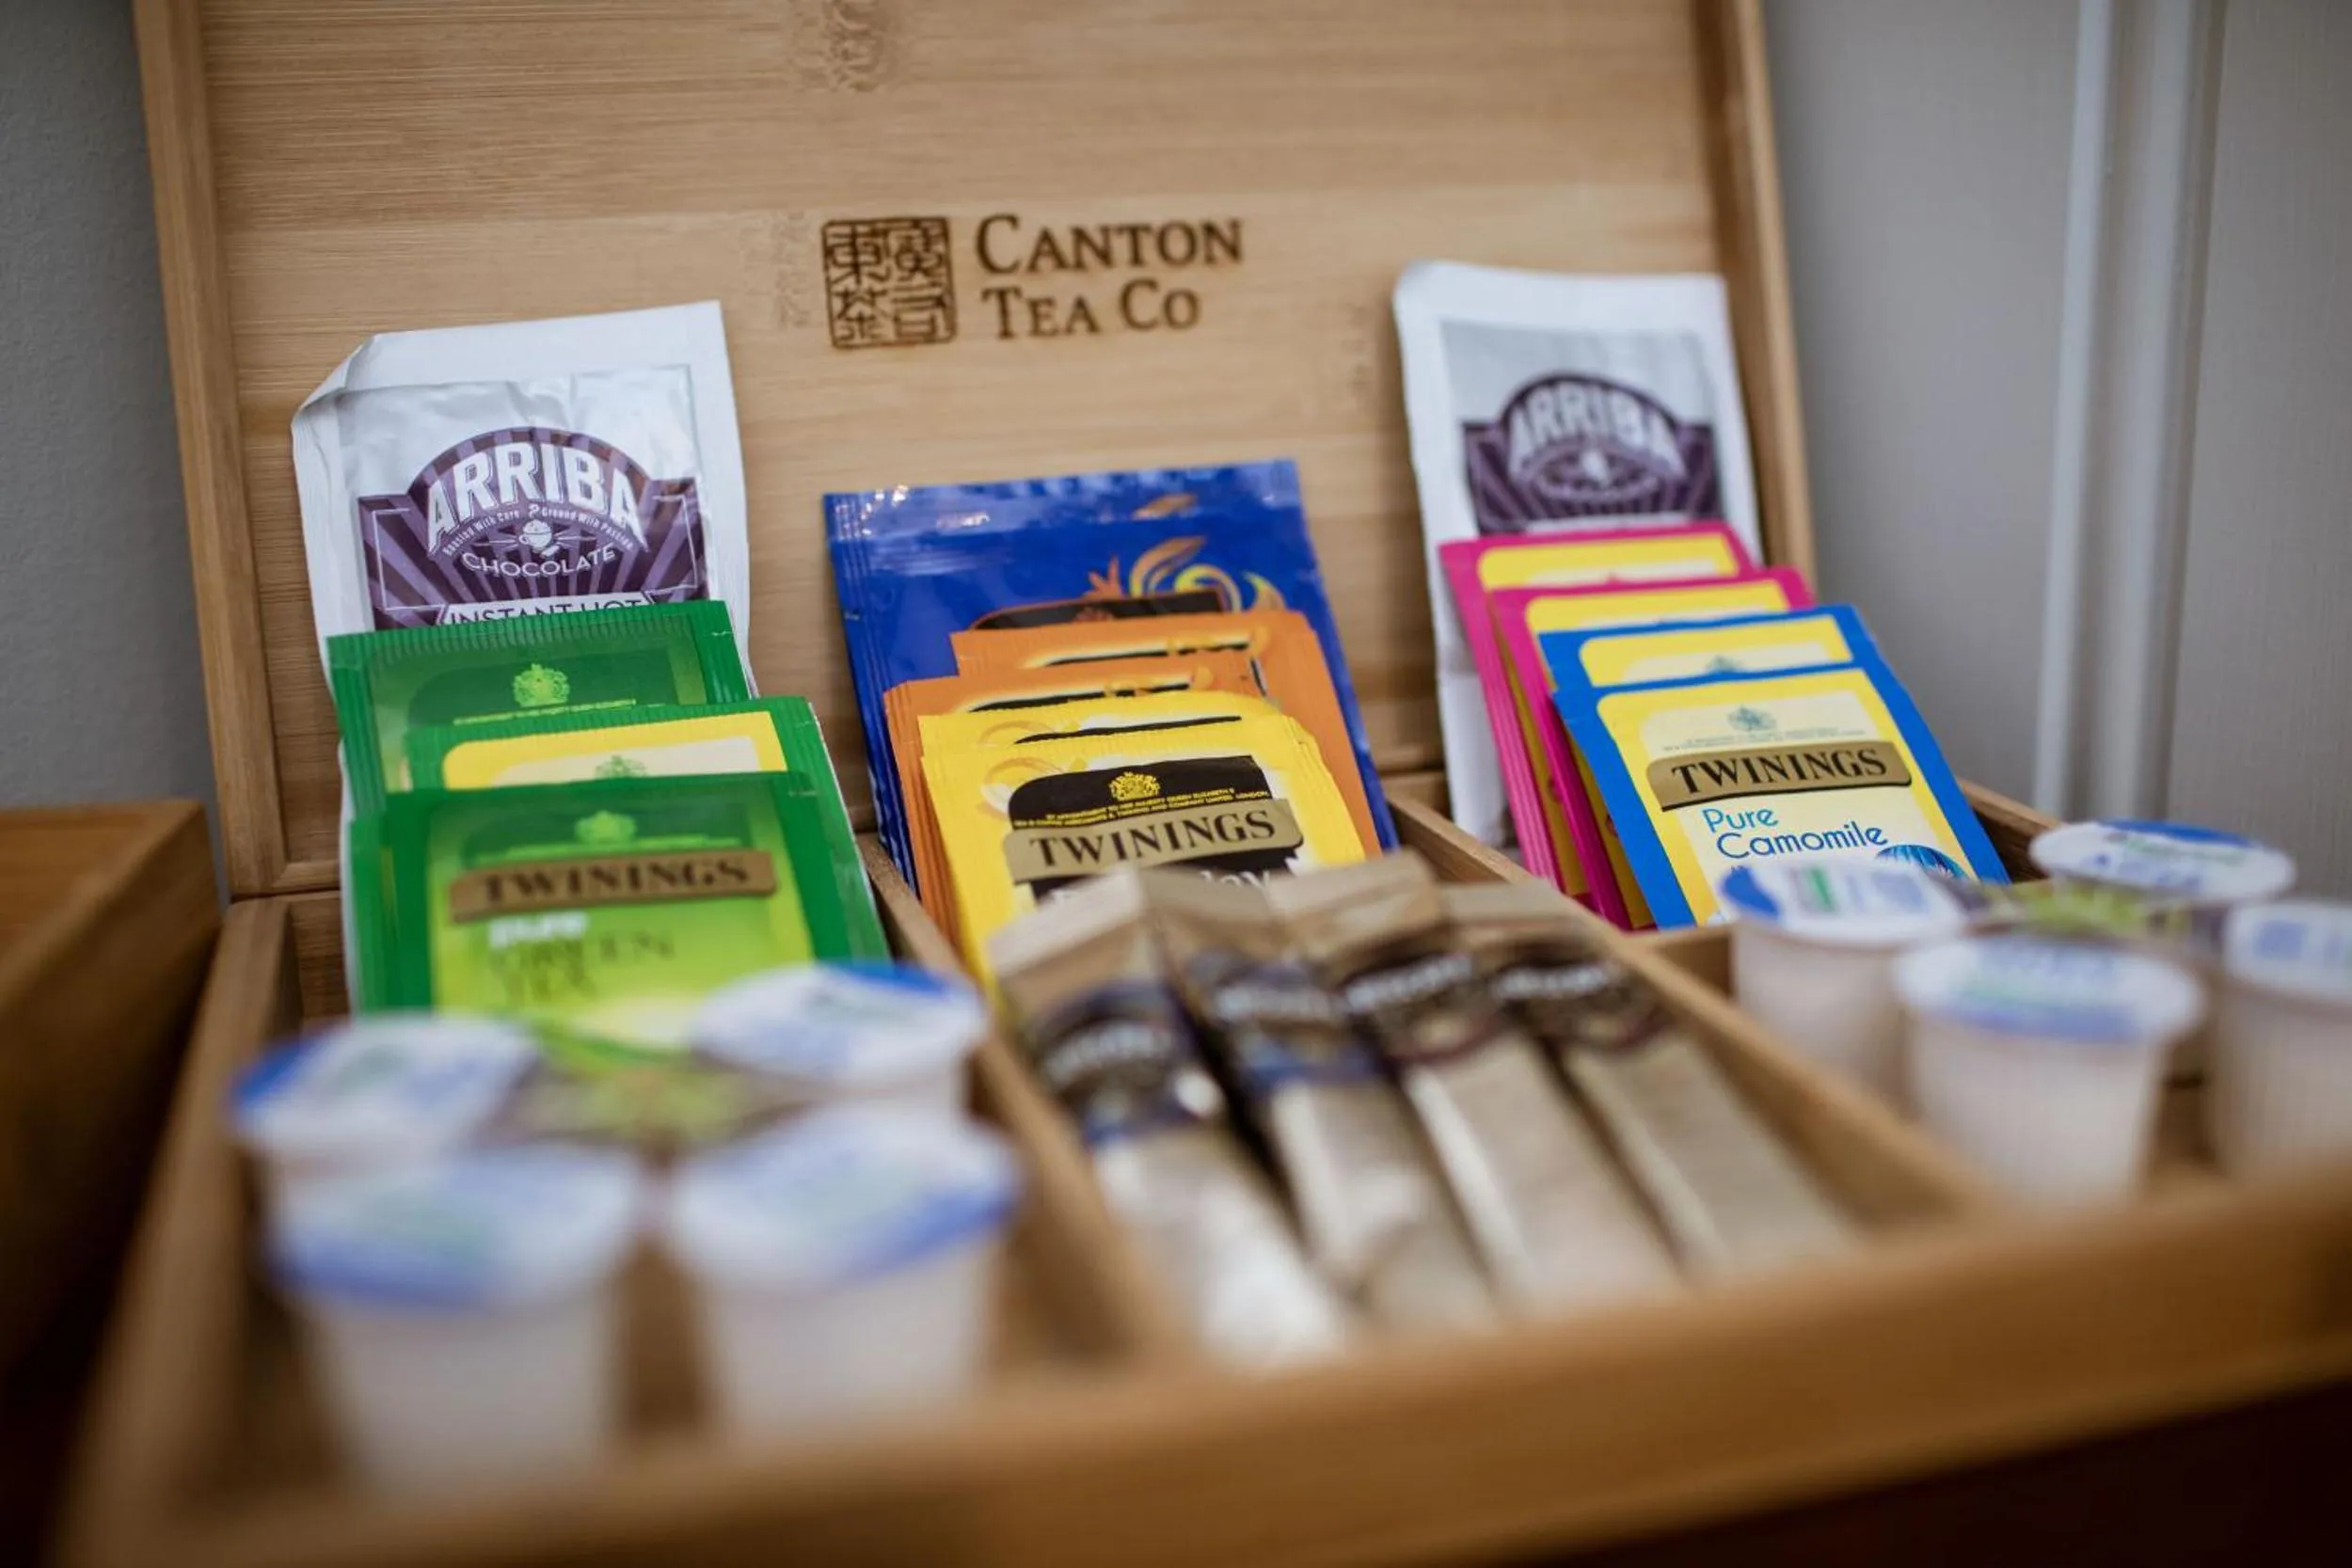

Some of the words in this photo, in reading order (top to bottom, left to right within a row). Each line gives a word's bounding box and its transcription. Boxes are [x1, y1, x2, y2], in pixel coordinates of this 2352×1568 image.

[976, 214, 1244, 275] CANTON
[981, 285, 1101, 340] TEA
[1507, 381, 1687, 482] ARRIBA
[427, 442, 649, 553] ARRIBA
[462, 544, 615, 578] CHOCOLATE
[1672, 749, 1887, 794] TWININGS
[1030, 810, 1276, 867] TWININGS
[1702, 806, 1779, 833] Pure
[1716, 821, 1889, 859] Camomile
[483, 861, 750, 902] TWININGS
